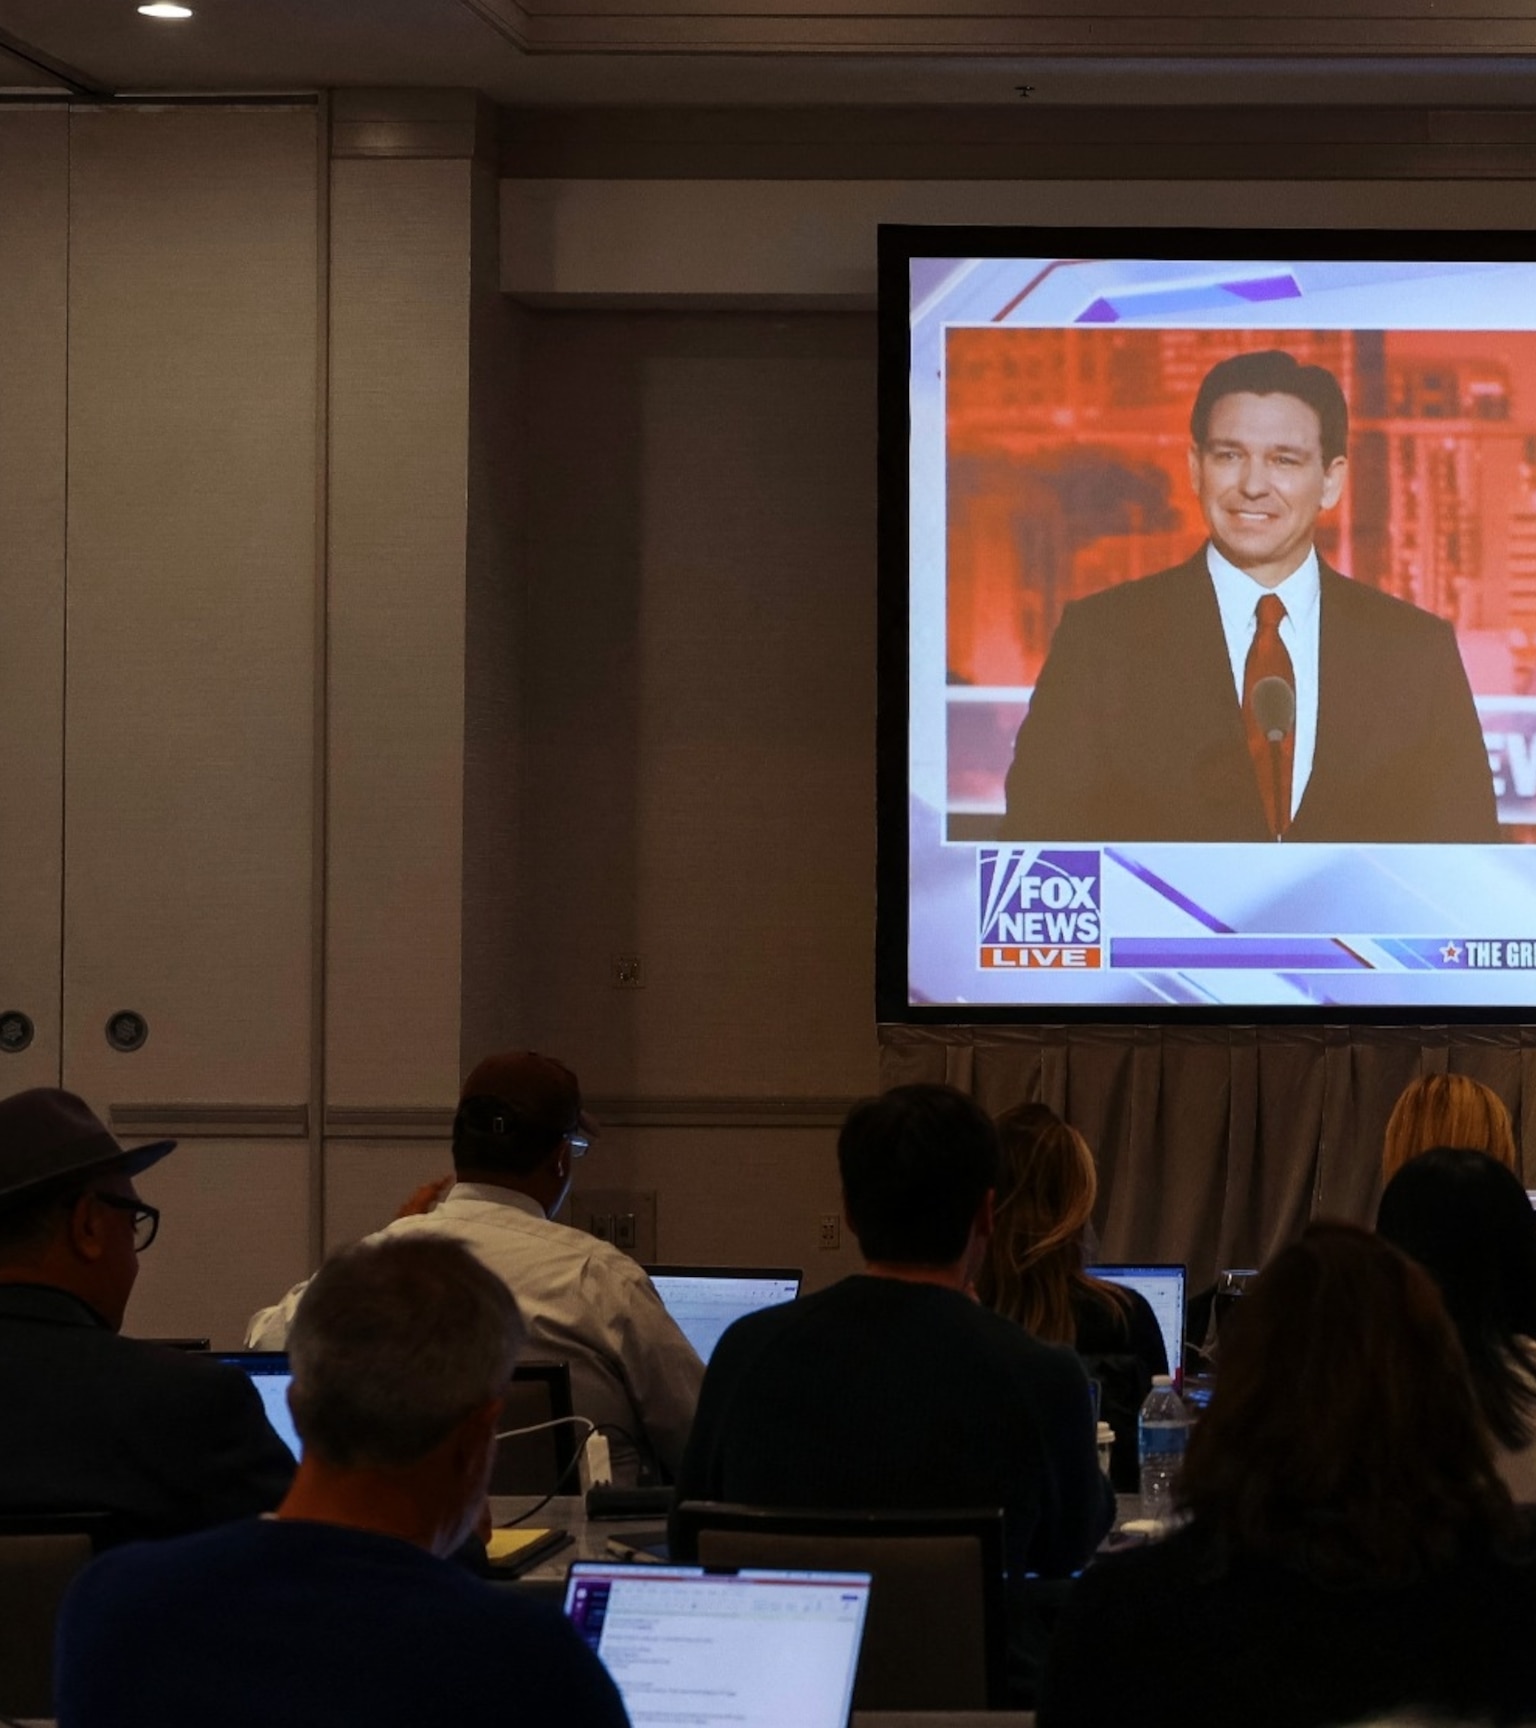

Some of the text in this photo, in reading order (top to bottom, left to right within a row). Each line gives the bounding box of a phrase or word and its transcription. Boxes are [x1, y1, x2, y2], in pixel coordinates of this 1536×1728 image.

[1020, 875, 1096, 909] FOX
[998, 911, 1100, 943] NEWS
[993, 948, 1088, 967] LIVE
[1464, 941, 1502, 967] THE
